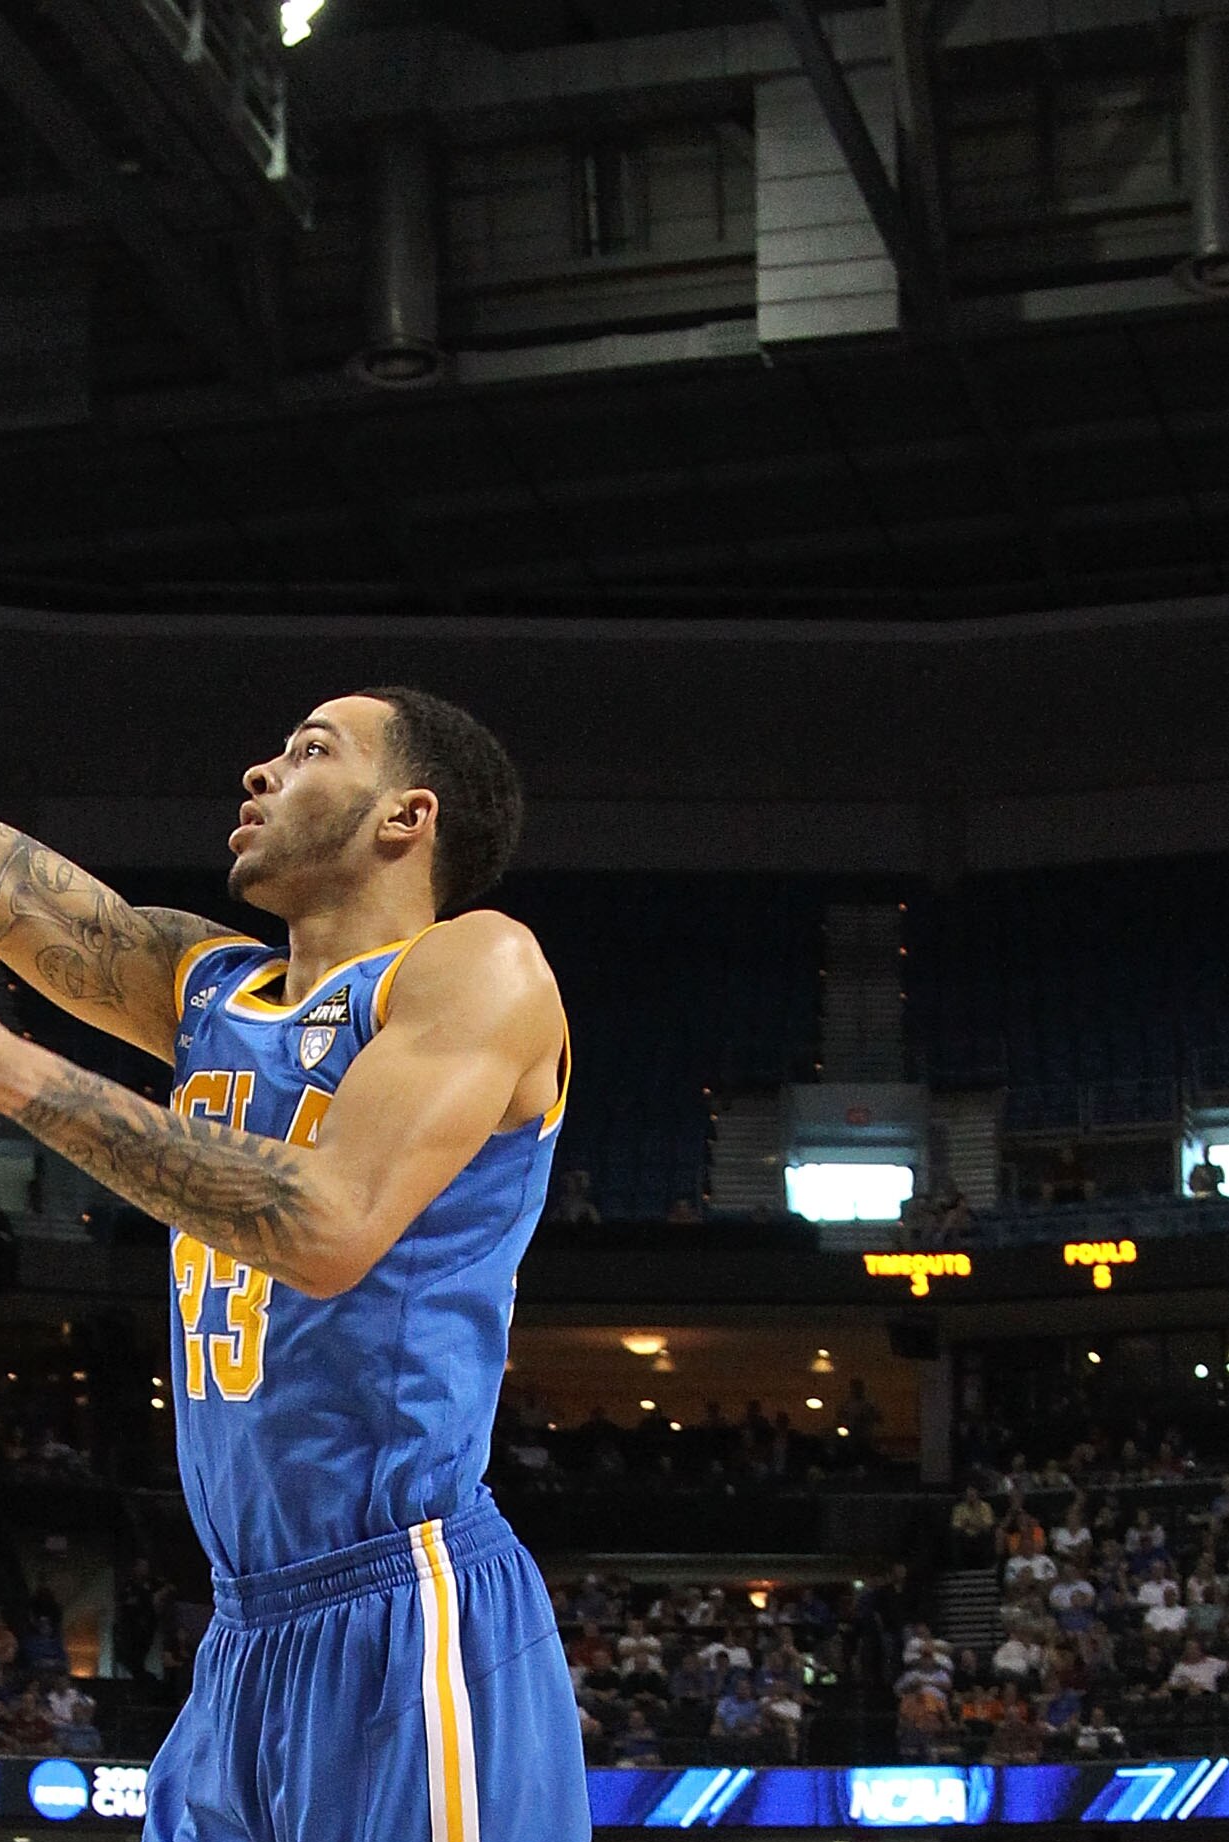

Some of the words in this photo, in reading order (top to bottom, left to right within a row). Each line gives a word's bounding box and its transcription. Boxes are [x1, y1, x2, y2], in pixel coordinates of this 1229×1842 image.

[308, 1004, 349, 1024] JRW
[1064, 1239, 1137, 1265] FOULS
[863, 1254, 971, 1276] TIMEOUTS
[849, 1778, 967, 1823] NCAA
